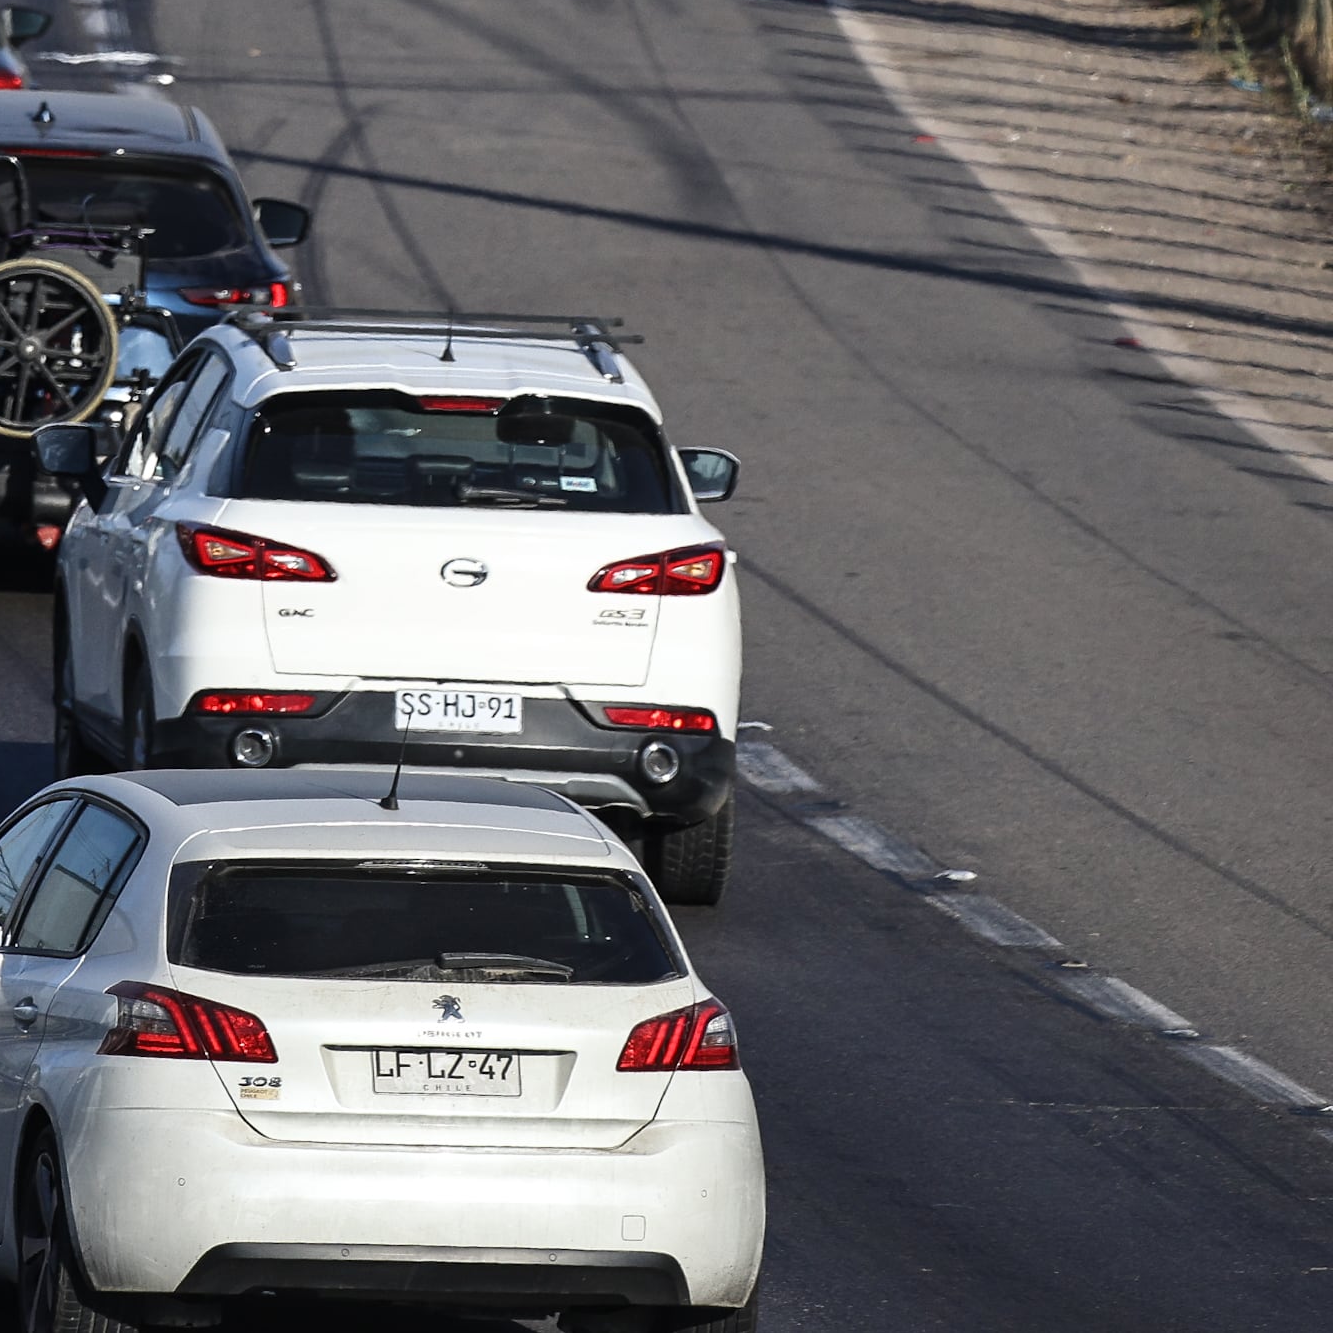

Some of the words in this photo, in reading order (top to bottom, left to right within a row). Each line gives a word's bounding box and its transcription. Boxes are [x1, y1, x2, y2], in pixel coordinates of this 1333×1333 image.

[599, 608, 646, 619] GS3
[238, 1076, 282, 1087] 308
[423, 1084, 472, 1092] CHILE
